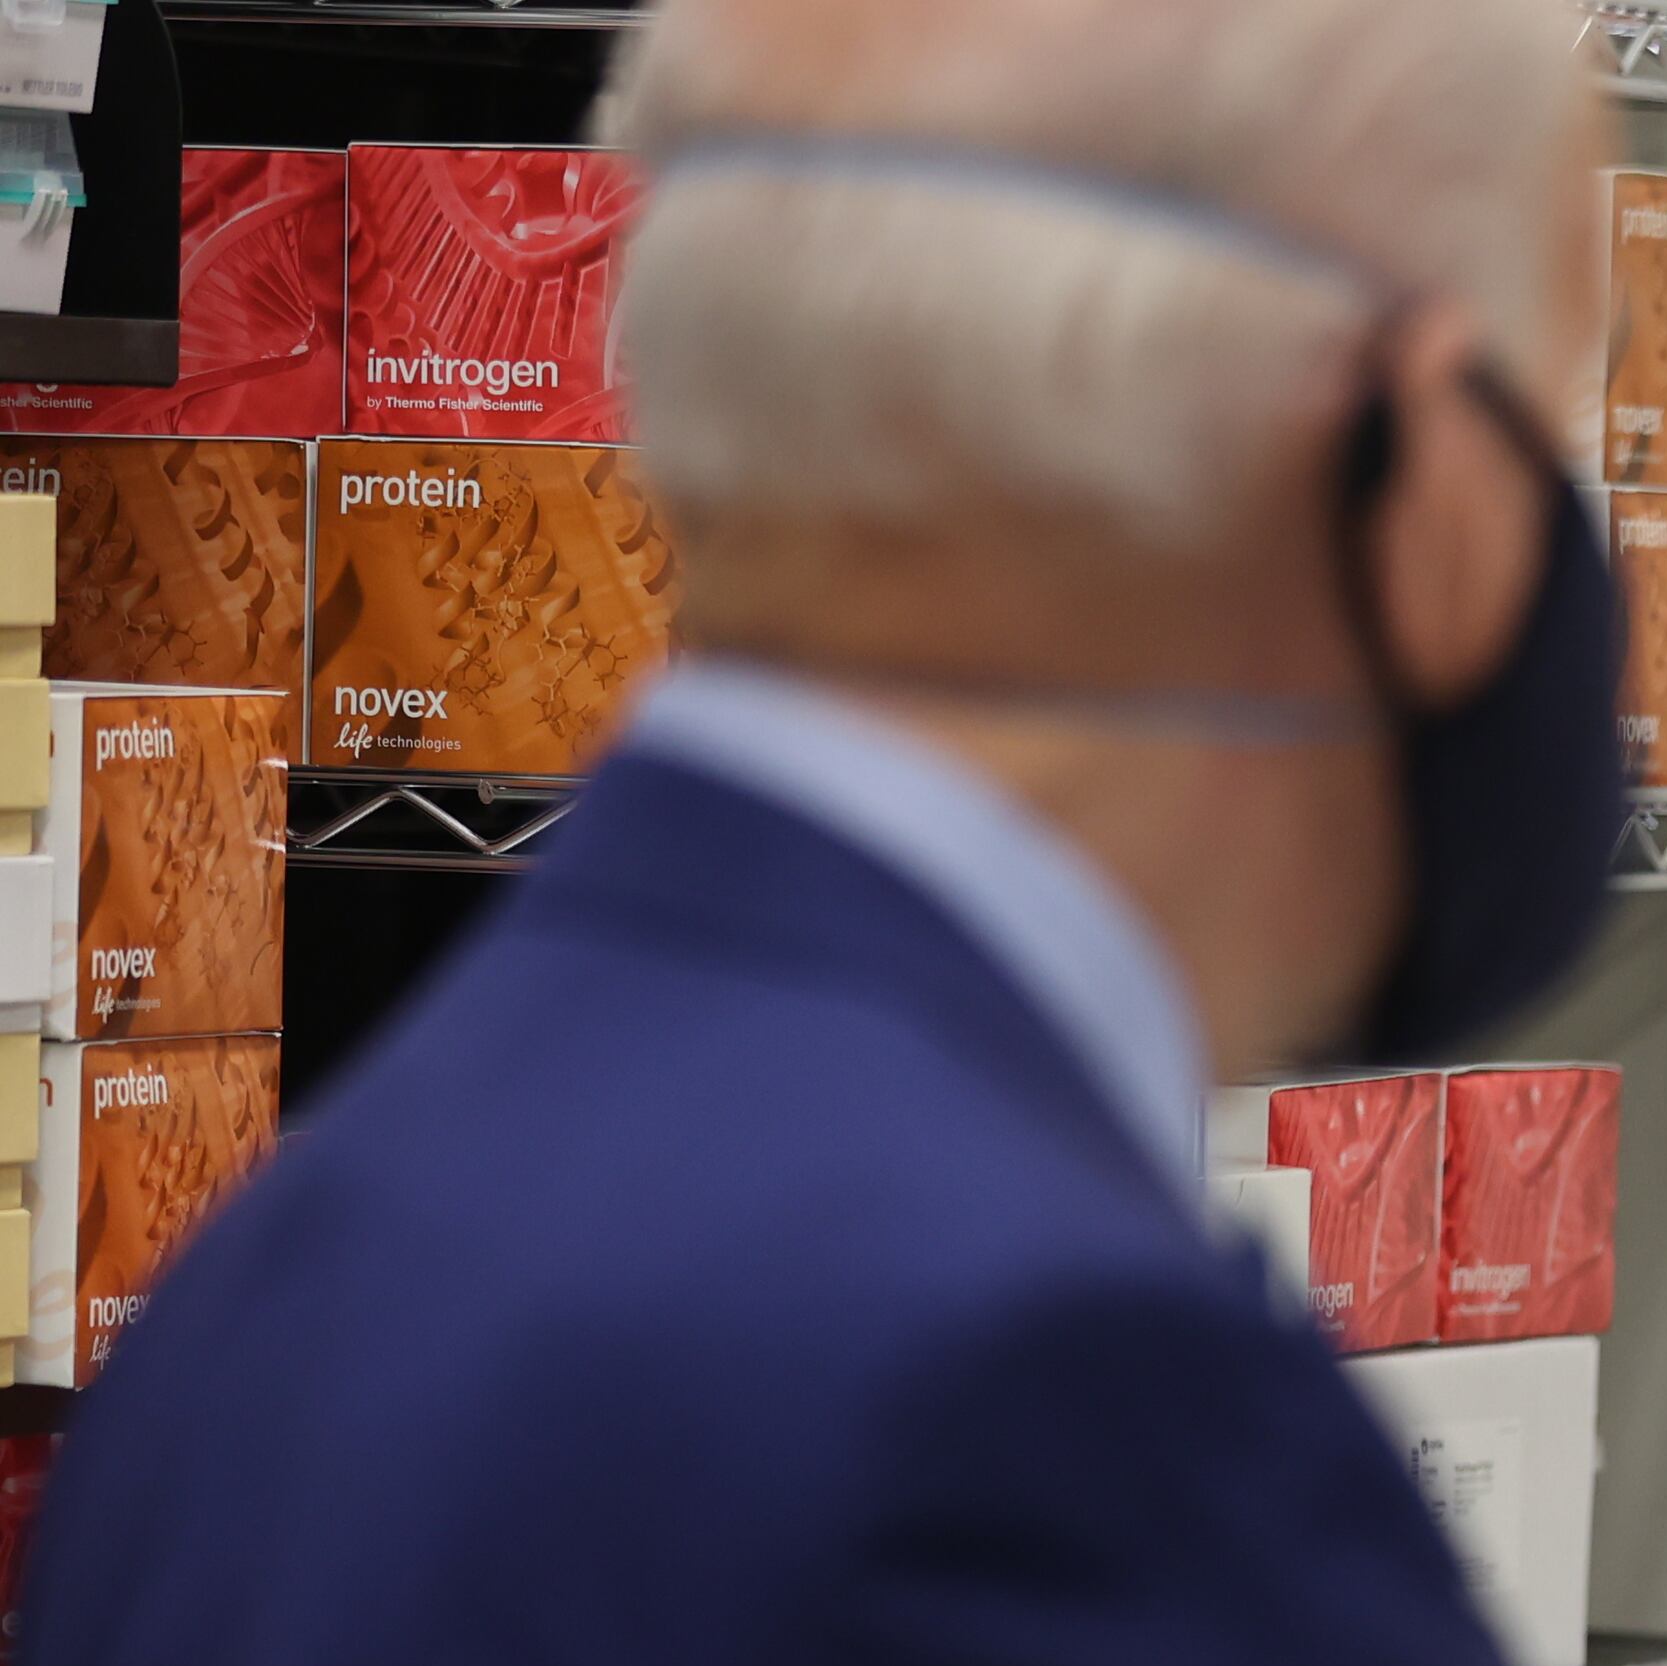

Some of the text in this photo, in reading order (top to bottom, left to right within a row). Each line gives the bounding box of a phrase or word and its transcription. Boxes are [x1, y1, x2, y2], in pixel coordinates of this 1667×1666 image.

[367, 348, 559, 395] invitrogen
[32, 397, 93, 409] Scientific
[367, 396, 543, 412] by Thermo Fisher Scientific
[1, 457, 61, 497] ein
[340, 468, 480, 514] protein
[335, 686, 448, 719] novex
[96, 717, 174, 772] protein
[334, 722, 462, 759] life technologies
[92, 947, 156, 981] novex
[92, 986, 115, 1024] life
[94, 1064, 167, 1119] protein
[1308, 1282, 1353, 1317] rogen
